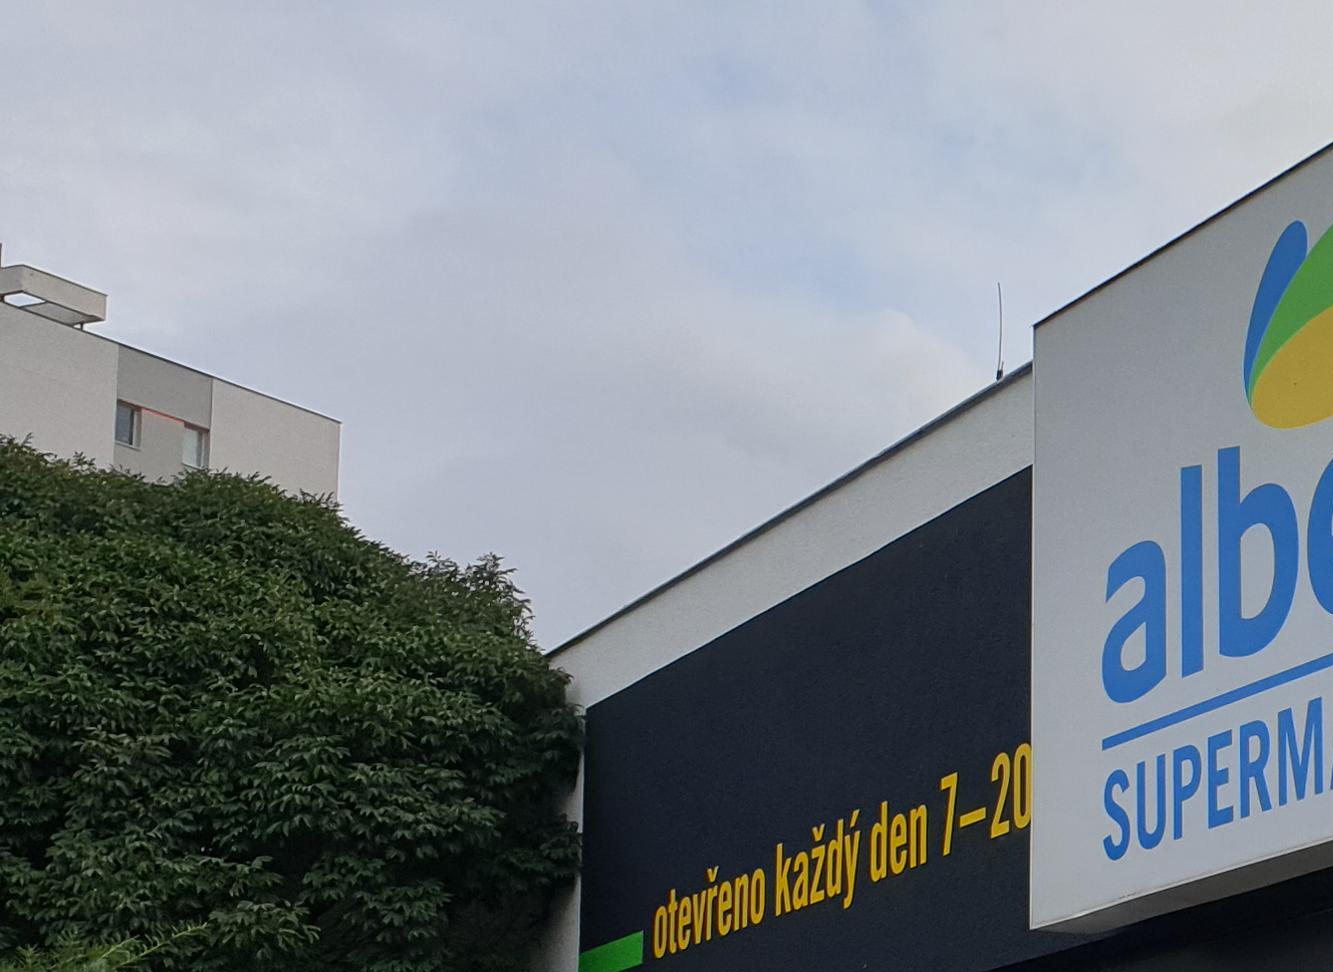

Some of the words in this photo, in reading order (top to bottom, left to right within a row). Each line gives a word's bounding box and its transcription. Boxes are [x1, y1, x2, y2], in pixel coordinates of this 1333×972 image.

[653, 865, 766, 961] otevřeno
[774, 808, 861, 917] každý
[869, 800, 929, 884] den
